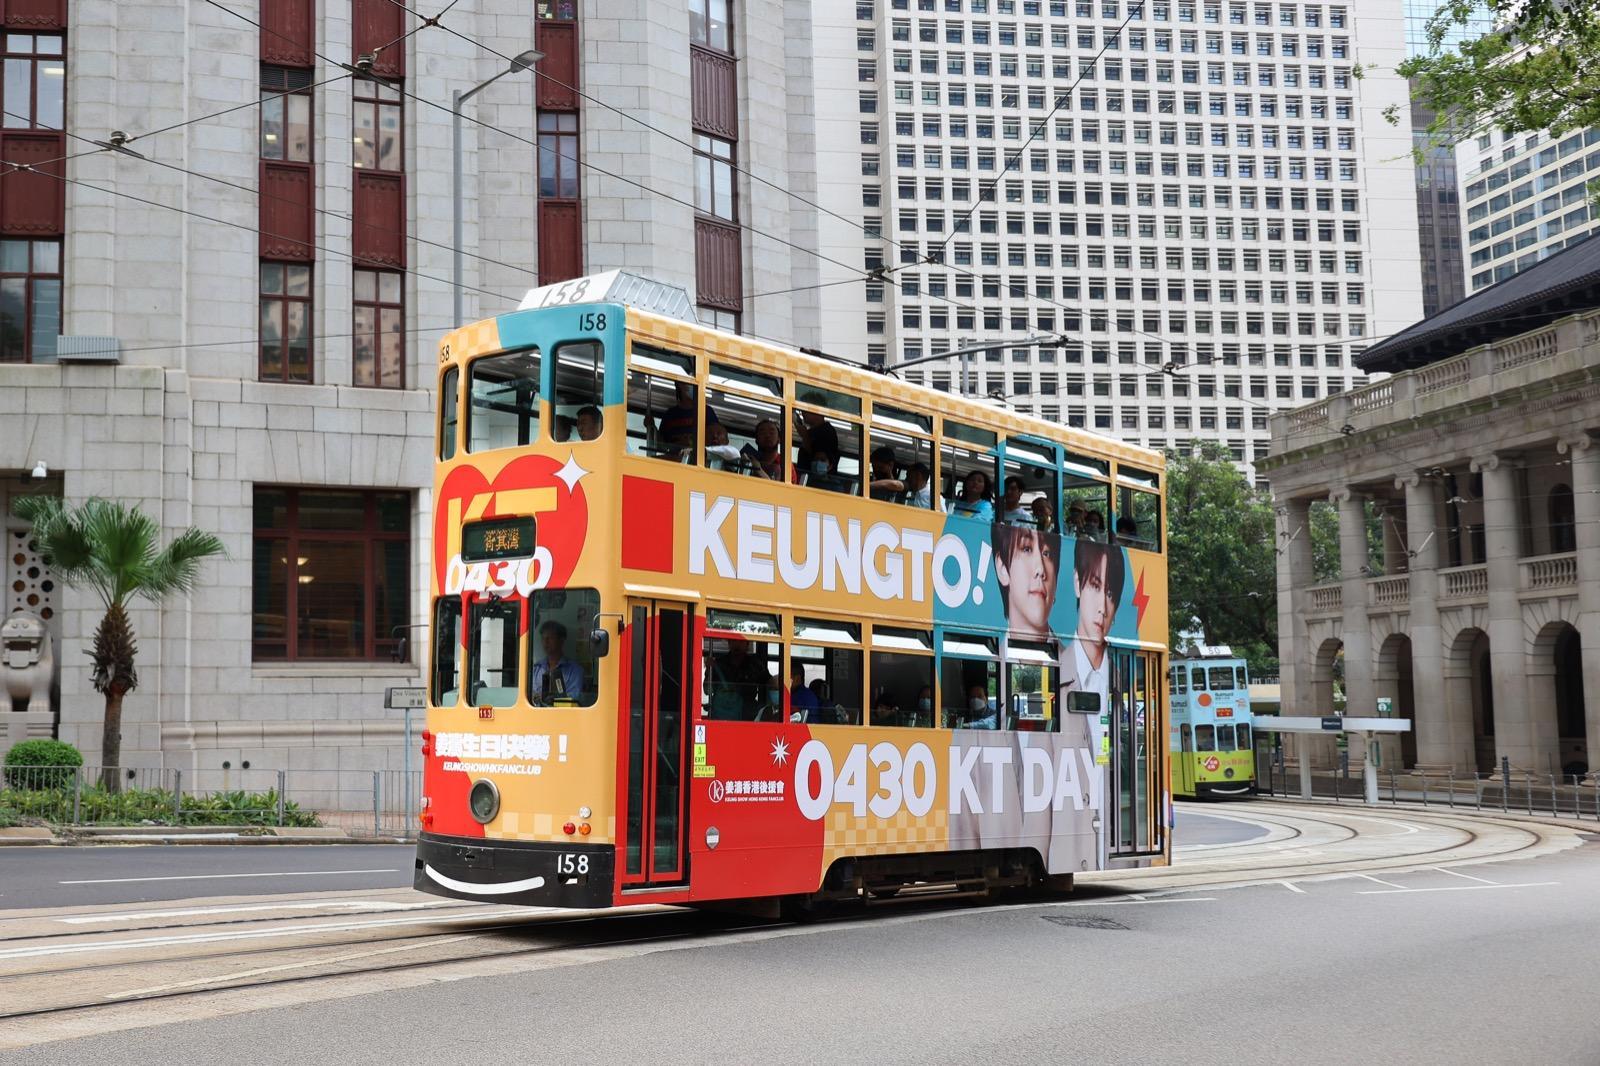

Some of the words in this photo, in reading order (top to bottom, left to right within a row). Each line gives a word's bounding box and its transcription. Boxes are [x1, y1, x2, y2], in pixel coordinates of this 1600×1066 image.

[539, 278, 590, 309] 158
[579, 313, 607, 332] 158
[688, 490, 993, 608] KEUNGTO!
[445, 546, 553, 599] 0430
[794, 739, 937, 821] 0430
[949, 746, 1013, 814] KT
[1023, 747, 1102, 813] DAY
[557, 853, 589, 874] 158
